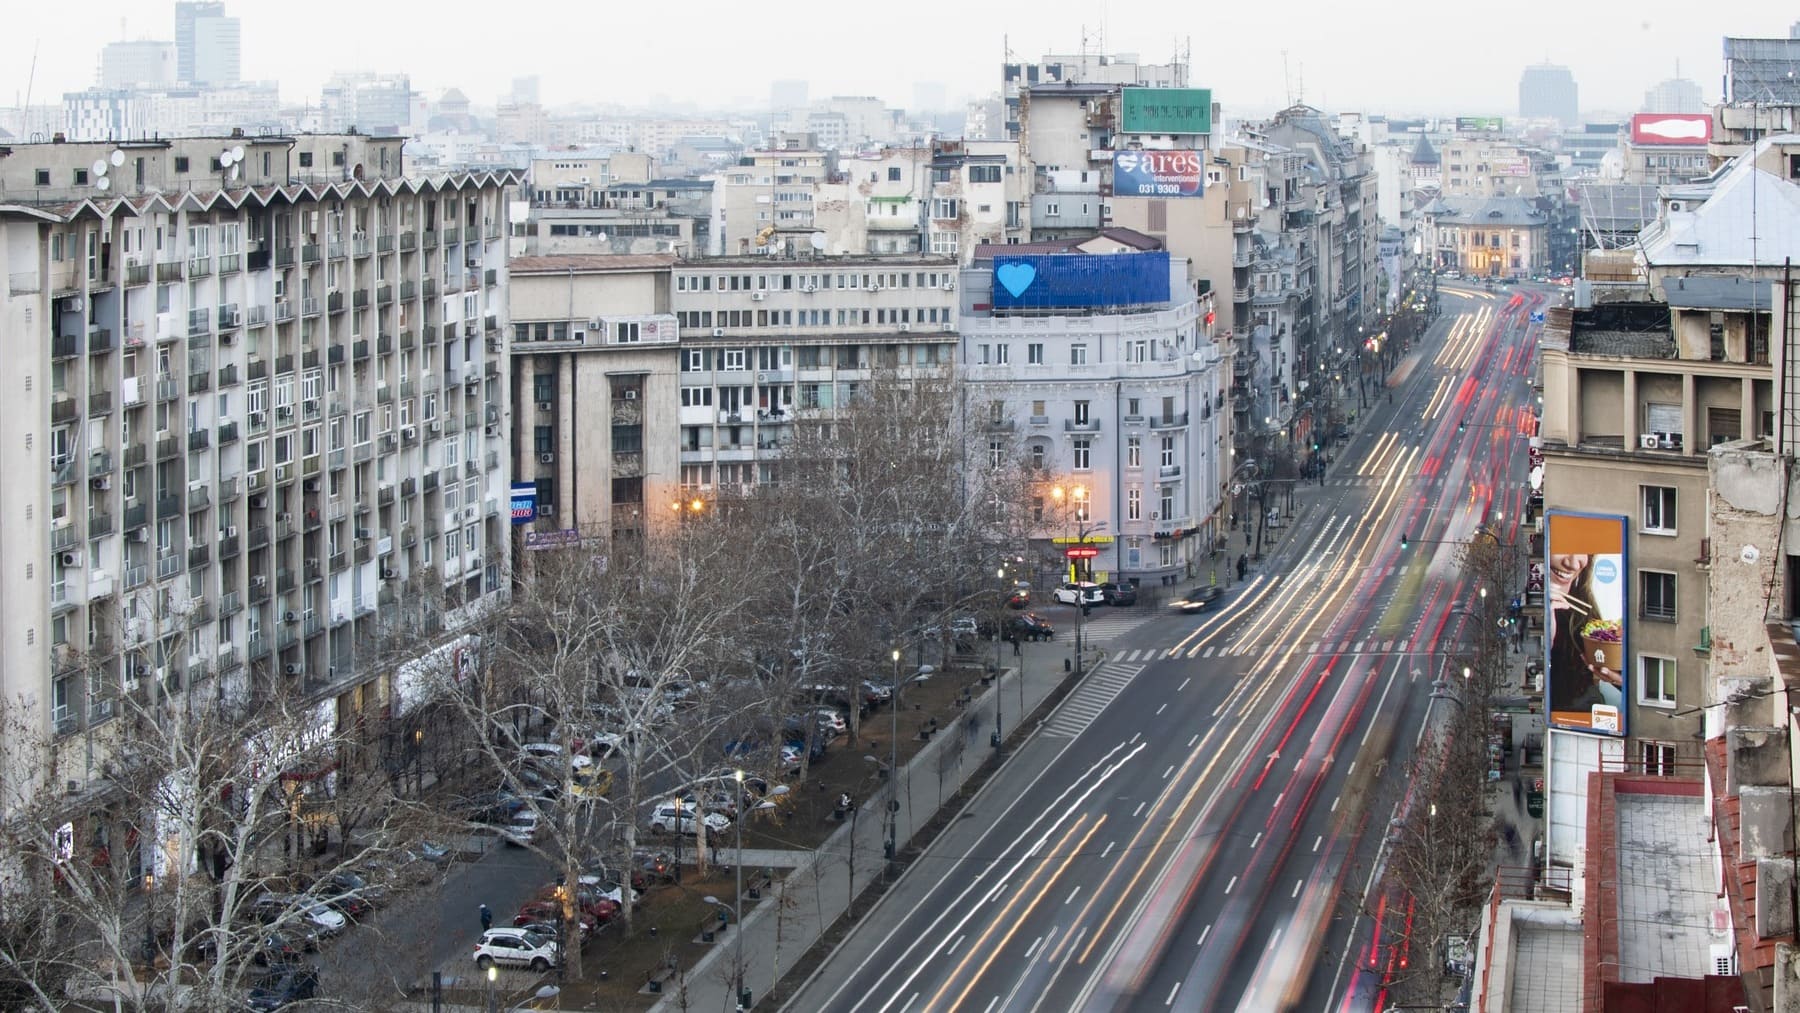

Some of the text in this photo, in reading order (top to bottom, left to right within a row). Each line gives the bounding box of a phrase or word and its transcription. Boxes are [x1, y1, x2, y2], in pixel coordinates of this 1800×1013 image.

[1140, 154, 1201, 174] ares
[1139, 184, 1180, 194] 031 9300
